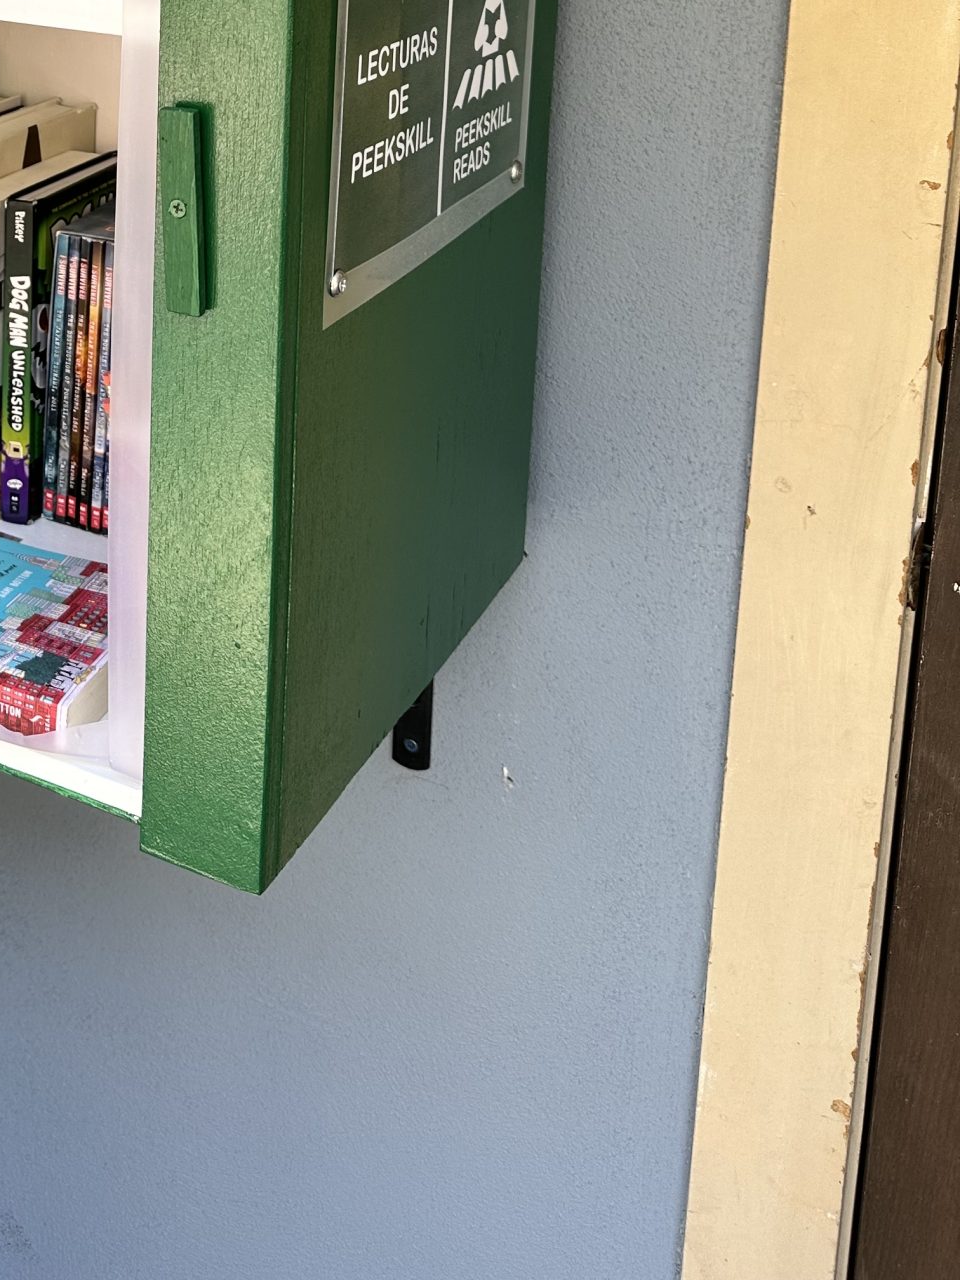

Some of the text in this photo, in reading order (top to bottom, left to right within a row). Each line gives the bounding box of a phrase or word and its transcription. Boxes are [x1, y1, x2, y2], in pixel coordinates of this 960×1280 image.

[357, 26, 438, 86] LECTURAS
[388, 83, 410, 120] DE
[454, 101, 513, 153] PEEKSKILL
[351, 117, 434, 184] PEEKSKILL
[453, 141, 490, 184] READS
[10, 275, 31, 312] DOG
[57, 259, 67, 295] SURVIVED
[68, 261, 78, 300] SURVIVED
[79, 263, 88, 300] SURVIVED
[90, 269, 98, 307] SURVIVED
[103, 272, 112, 309] SURVIVED
[8, 312, 28, 348] MAN
